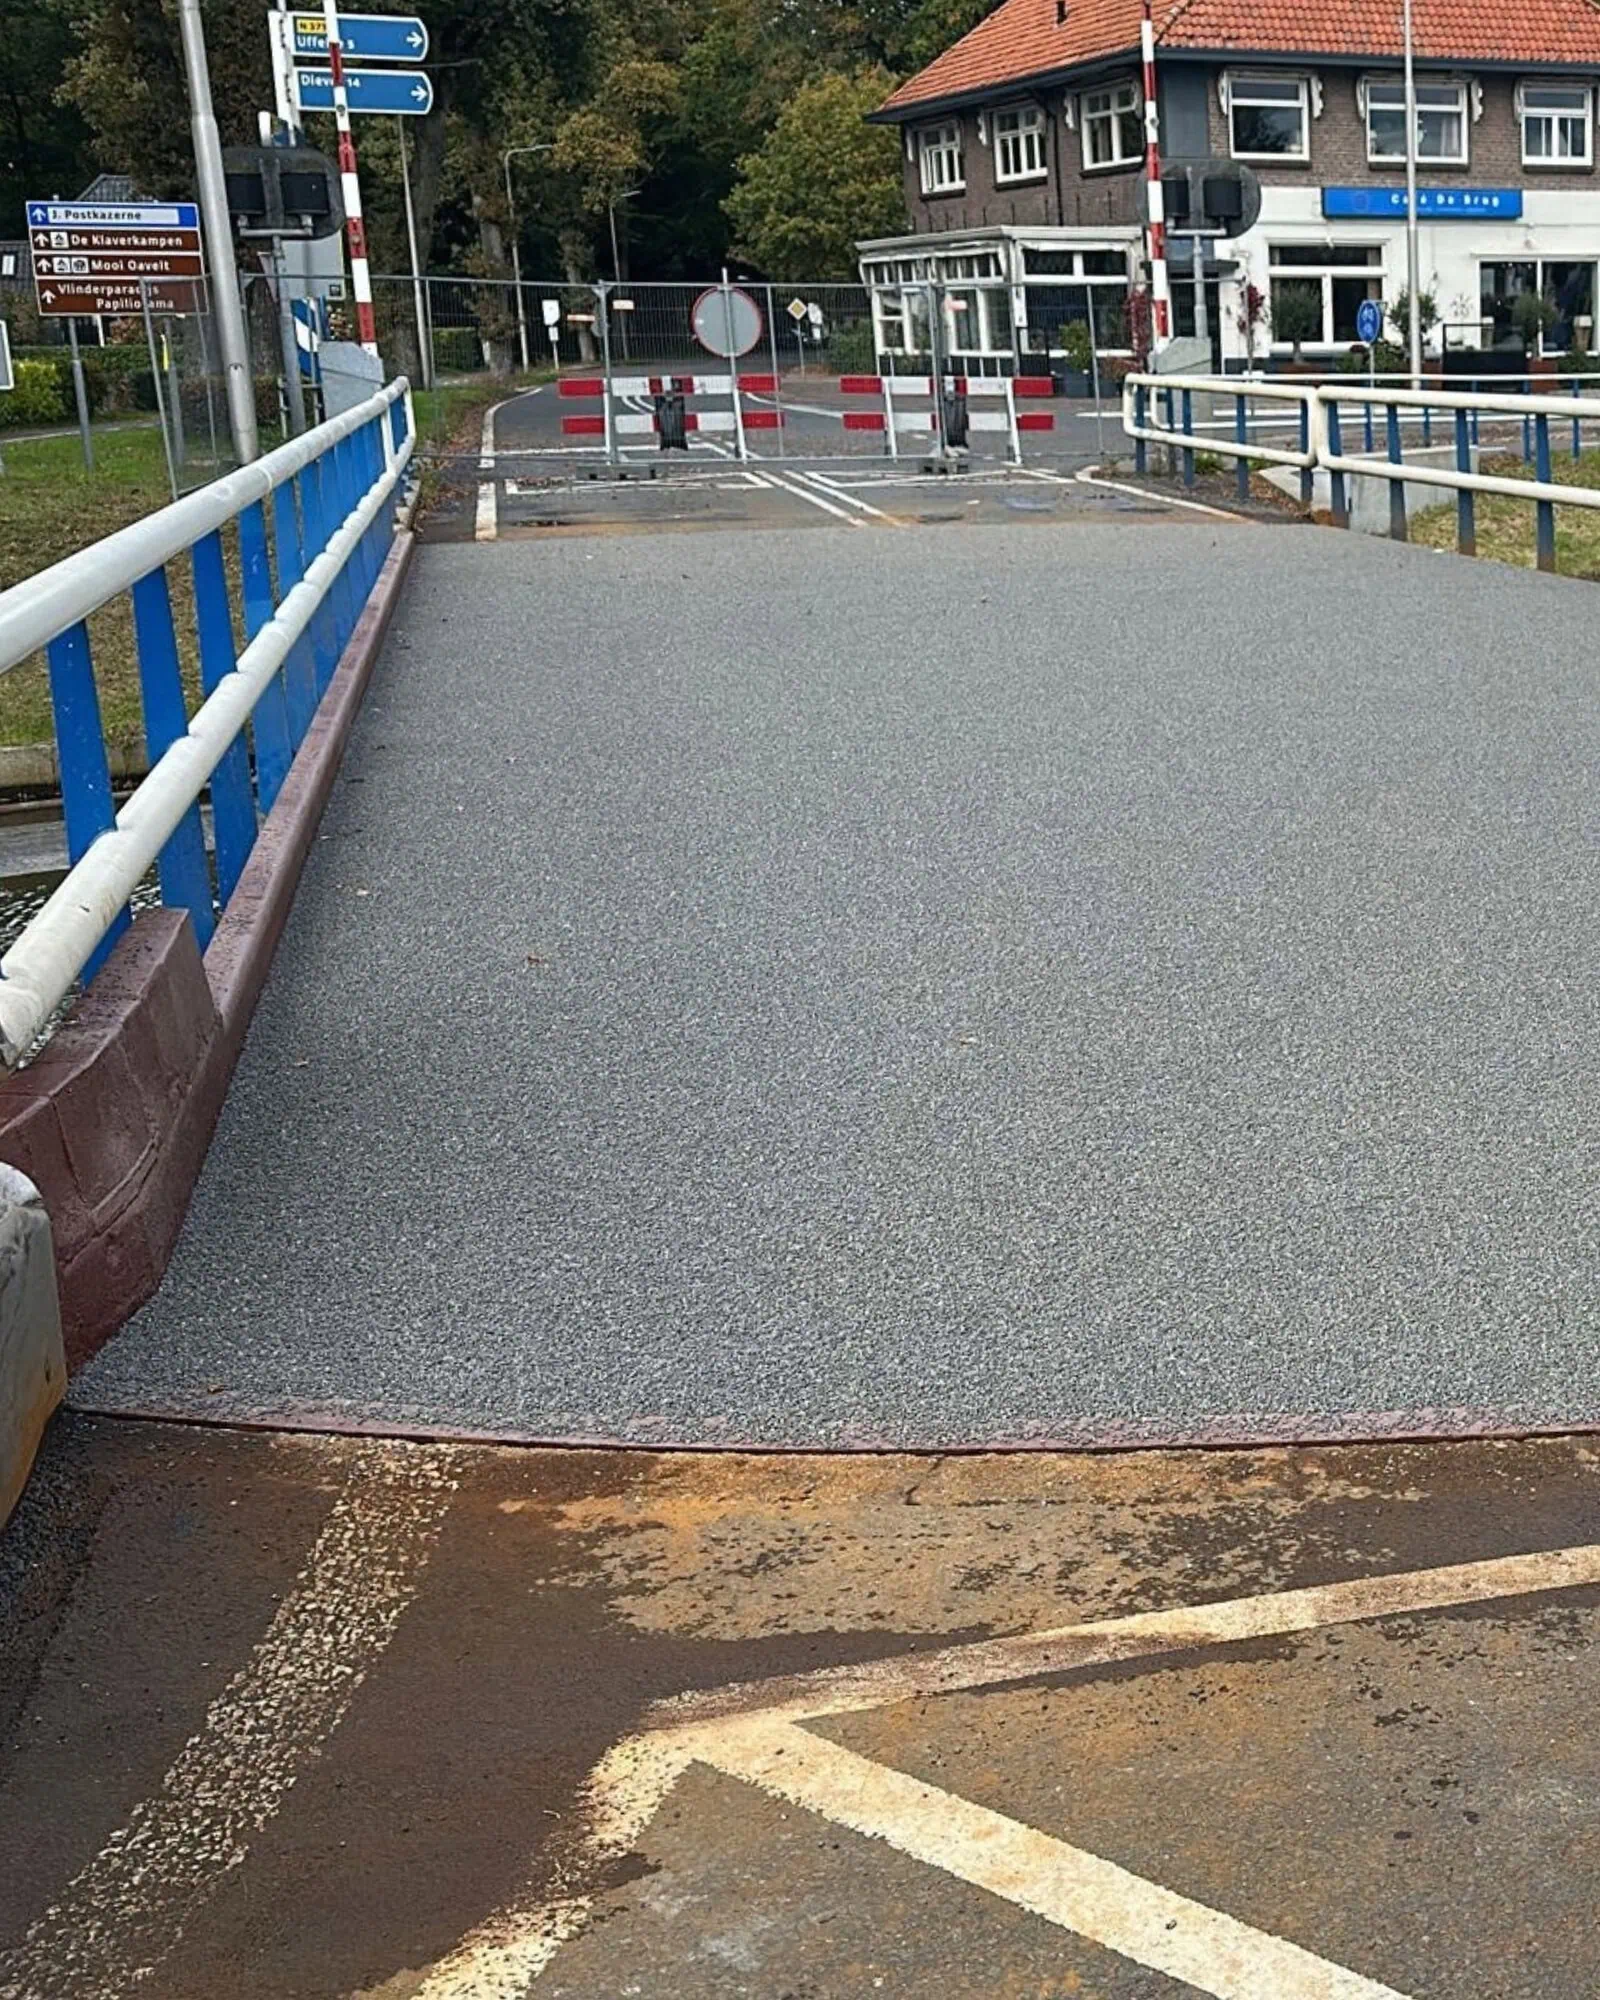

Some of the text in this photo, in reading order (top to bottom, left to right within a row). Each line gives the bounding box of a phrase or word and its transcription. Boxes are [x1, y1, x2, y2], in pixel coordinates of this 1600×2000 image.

[297, 36, 344, 49] Uffel
[300, 74, 341, 87] Diev
[1391, 193, 1427, 205] Caé
[65, 209, 142, 220] Postkazerne
[70, 234, 183, 247] De Klaverkampen
[90, 260, 124, 271] Mooi
[57, 284, 159, 297] Vlinderparajs
[96, 299, 174, 313] Papilioama
